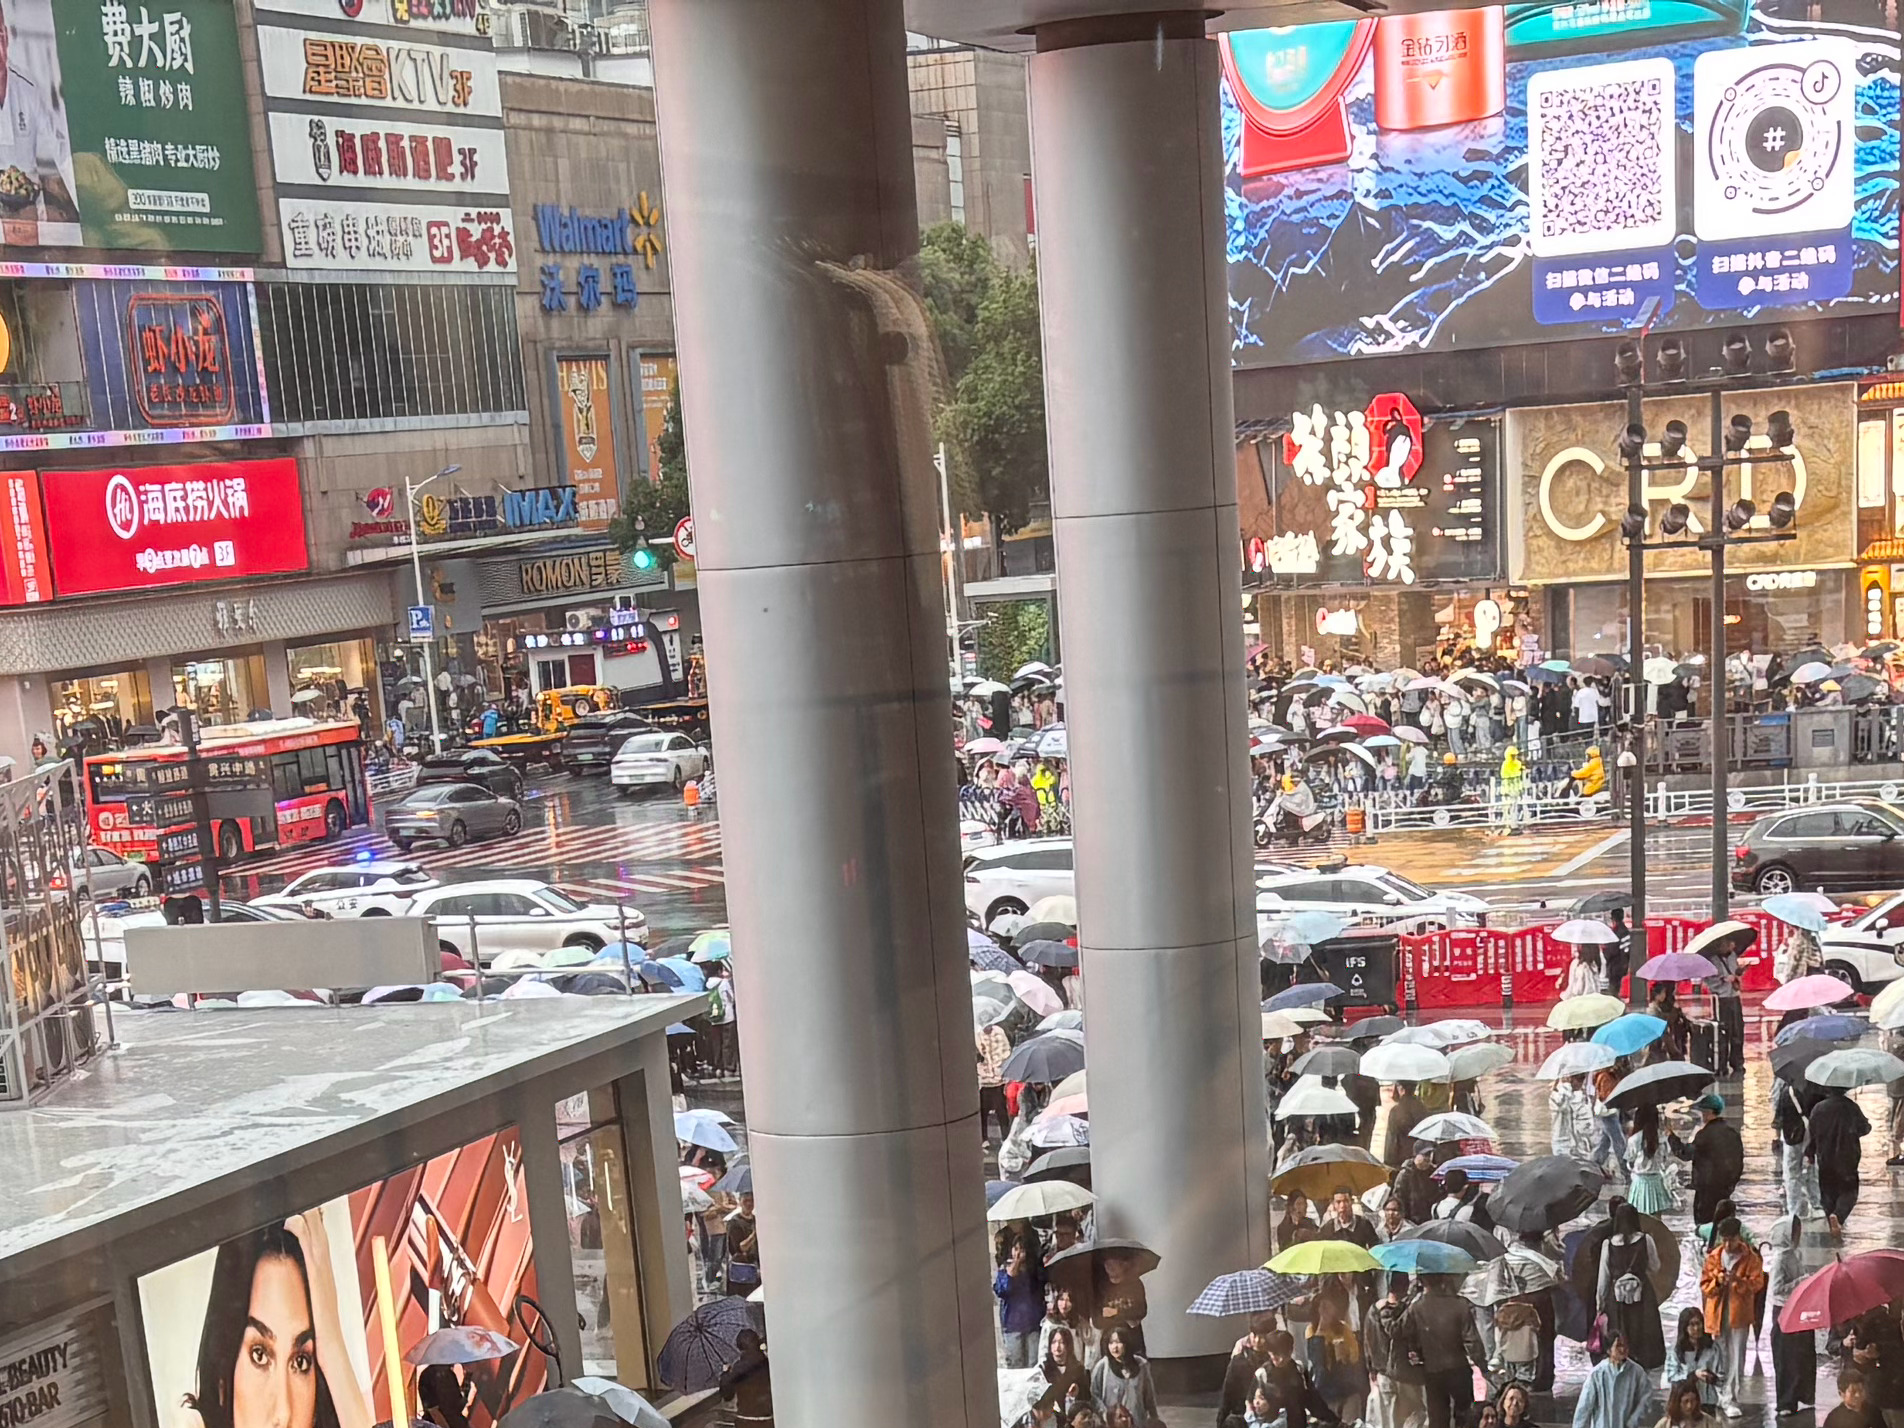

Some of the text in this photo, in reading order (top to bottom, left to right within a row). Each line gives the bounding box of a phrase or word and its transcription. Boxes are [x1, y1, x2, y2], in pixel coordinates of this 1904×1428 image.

[101, 0, 194, 75] 费大厨
[118, 75, 194, 111] 辣椒炒肉
[458, 148, 478, 181] 3F
[429, 226, 451, 258] 3F
[535, 203, 632, 254] Walmart
[539, 262, 638, 311] 沃尔玛
[140, 477, 249, 525] 海底捞火锅
[503, 487, 578, 528] IMAX
[521, 555, 590, 594] ROMON
[7, 1341, 68, 1391] BEAUTY
[25, 1381, 61, 1418] BAR
